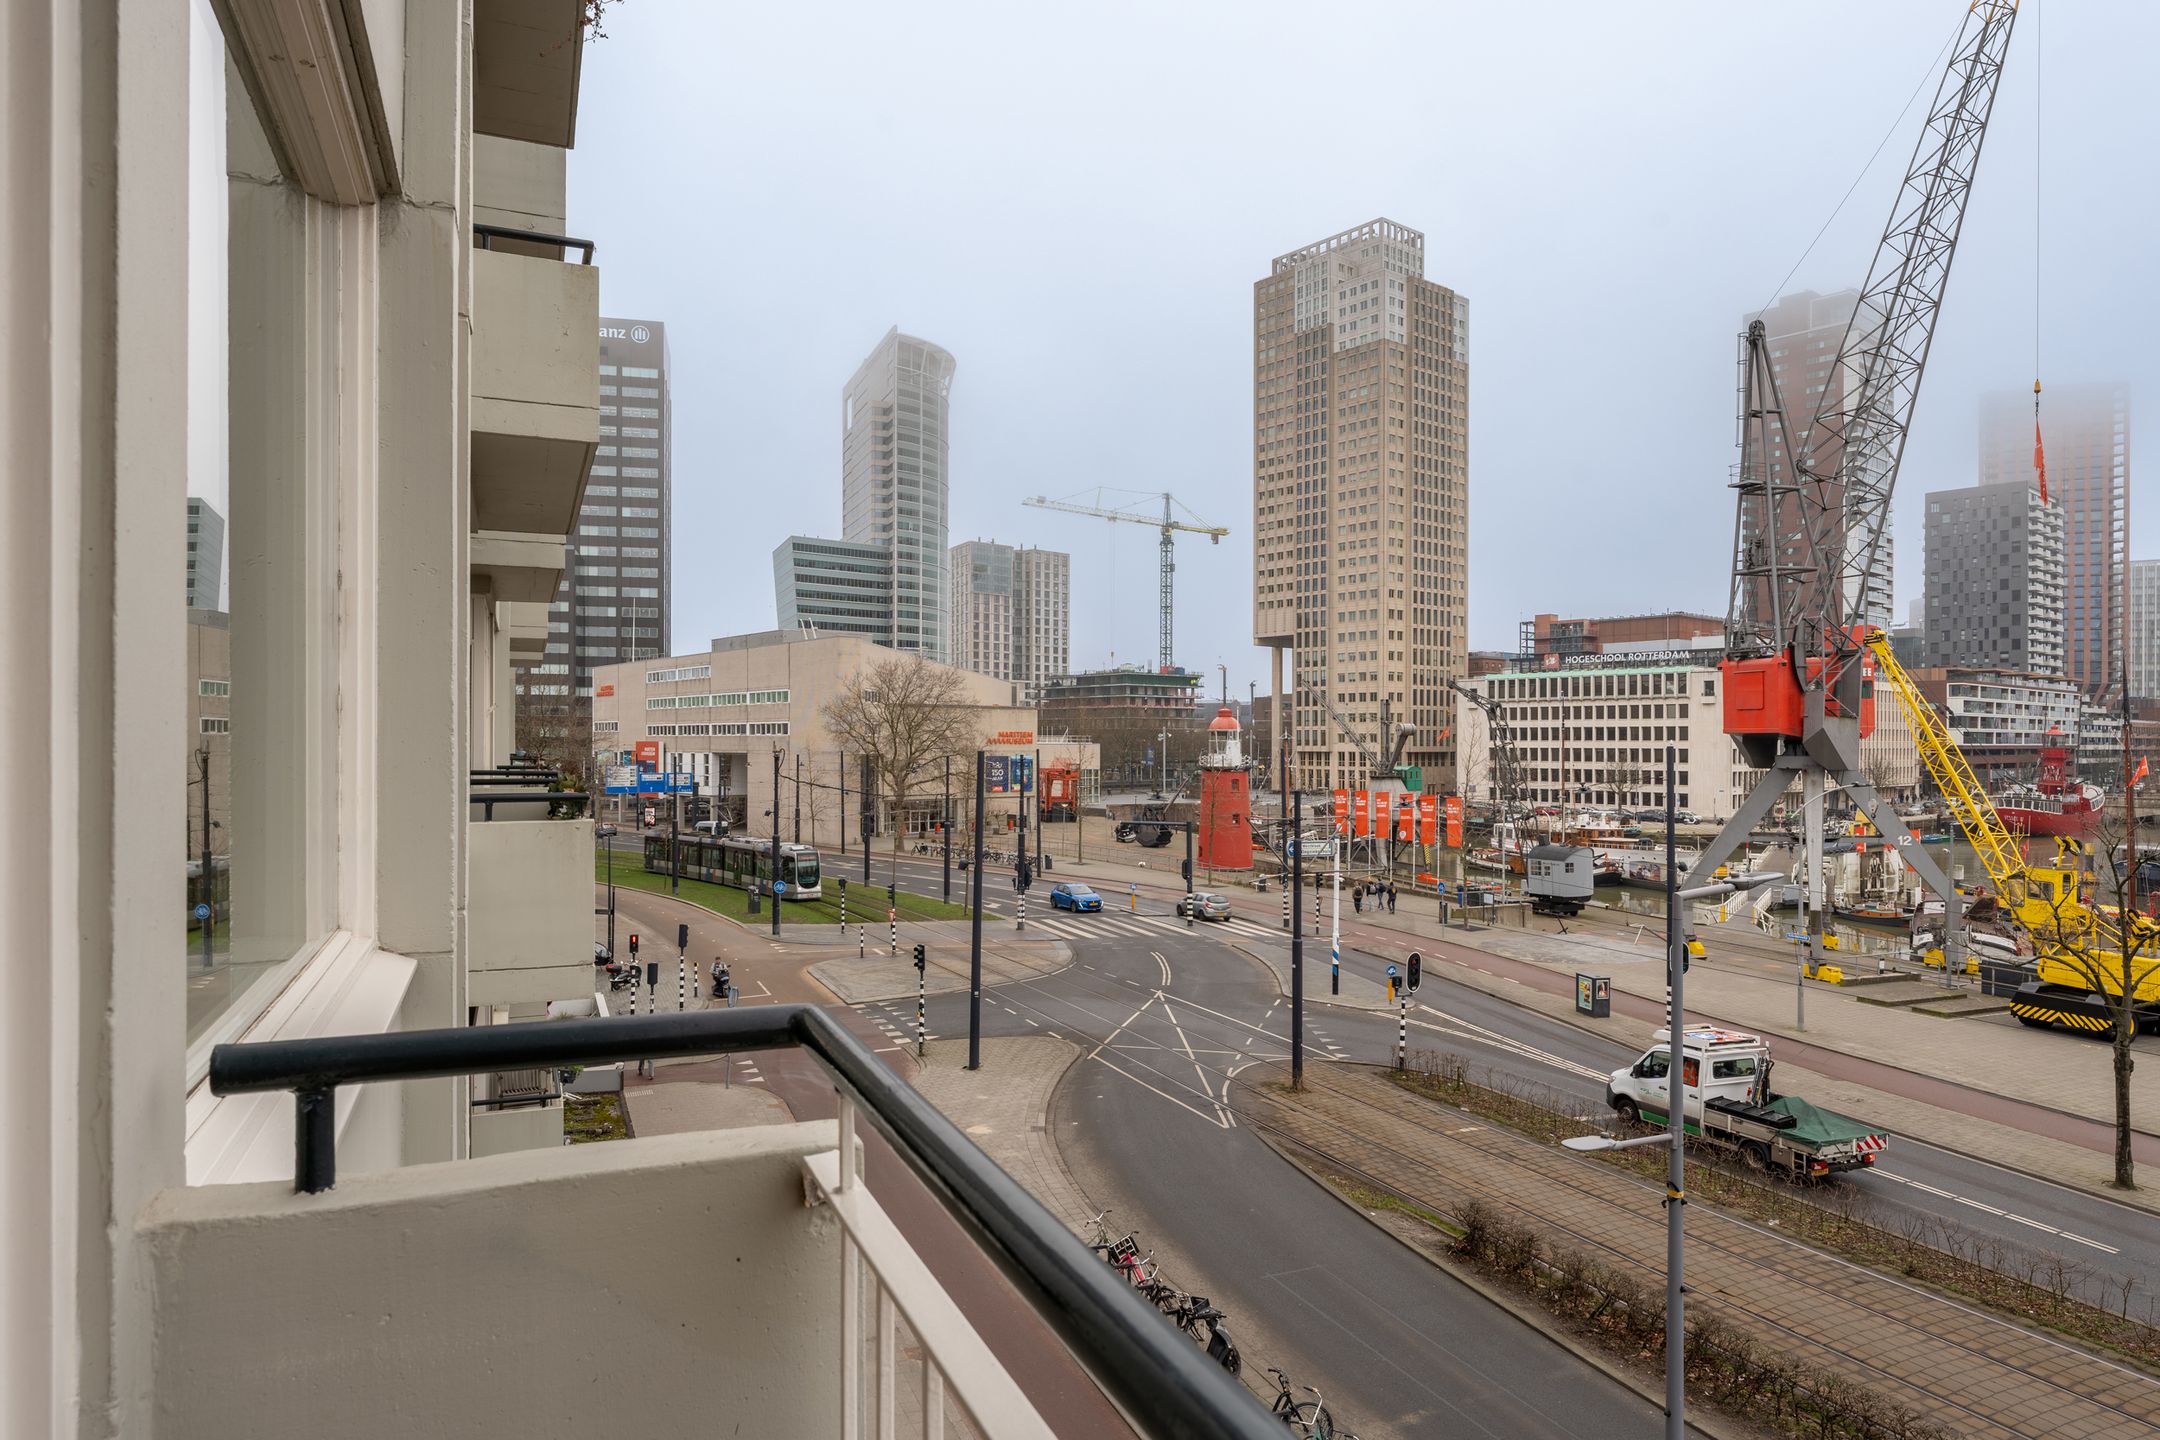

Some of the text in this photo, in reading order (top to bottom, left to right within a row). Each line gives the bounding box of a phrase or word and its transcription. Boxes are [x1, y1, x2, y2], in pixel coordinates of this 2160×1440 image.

[1565, 653, 1626, 664] HOGESCHOOL
[1628, 650, 1690, 661] ROTTERDAM
[1897, 835, 1912, 846] 12
